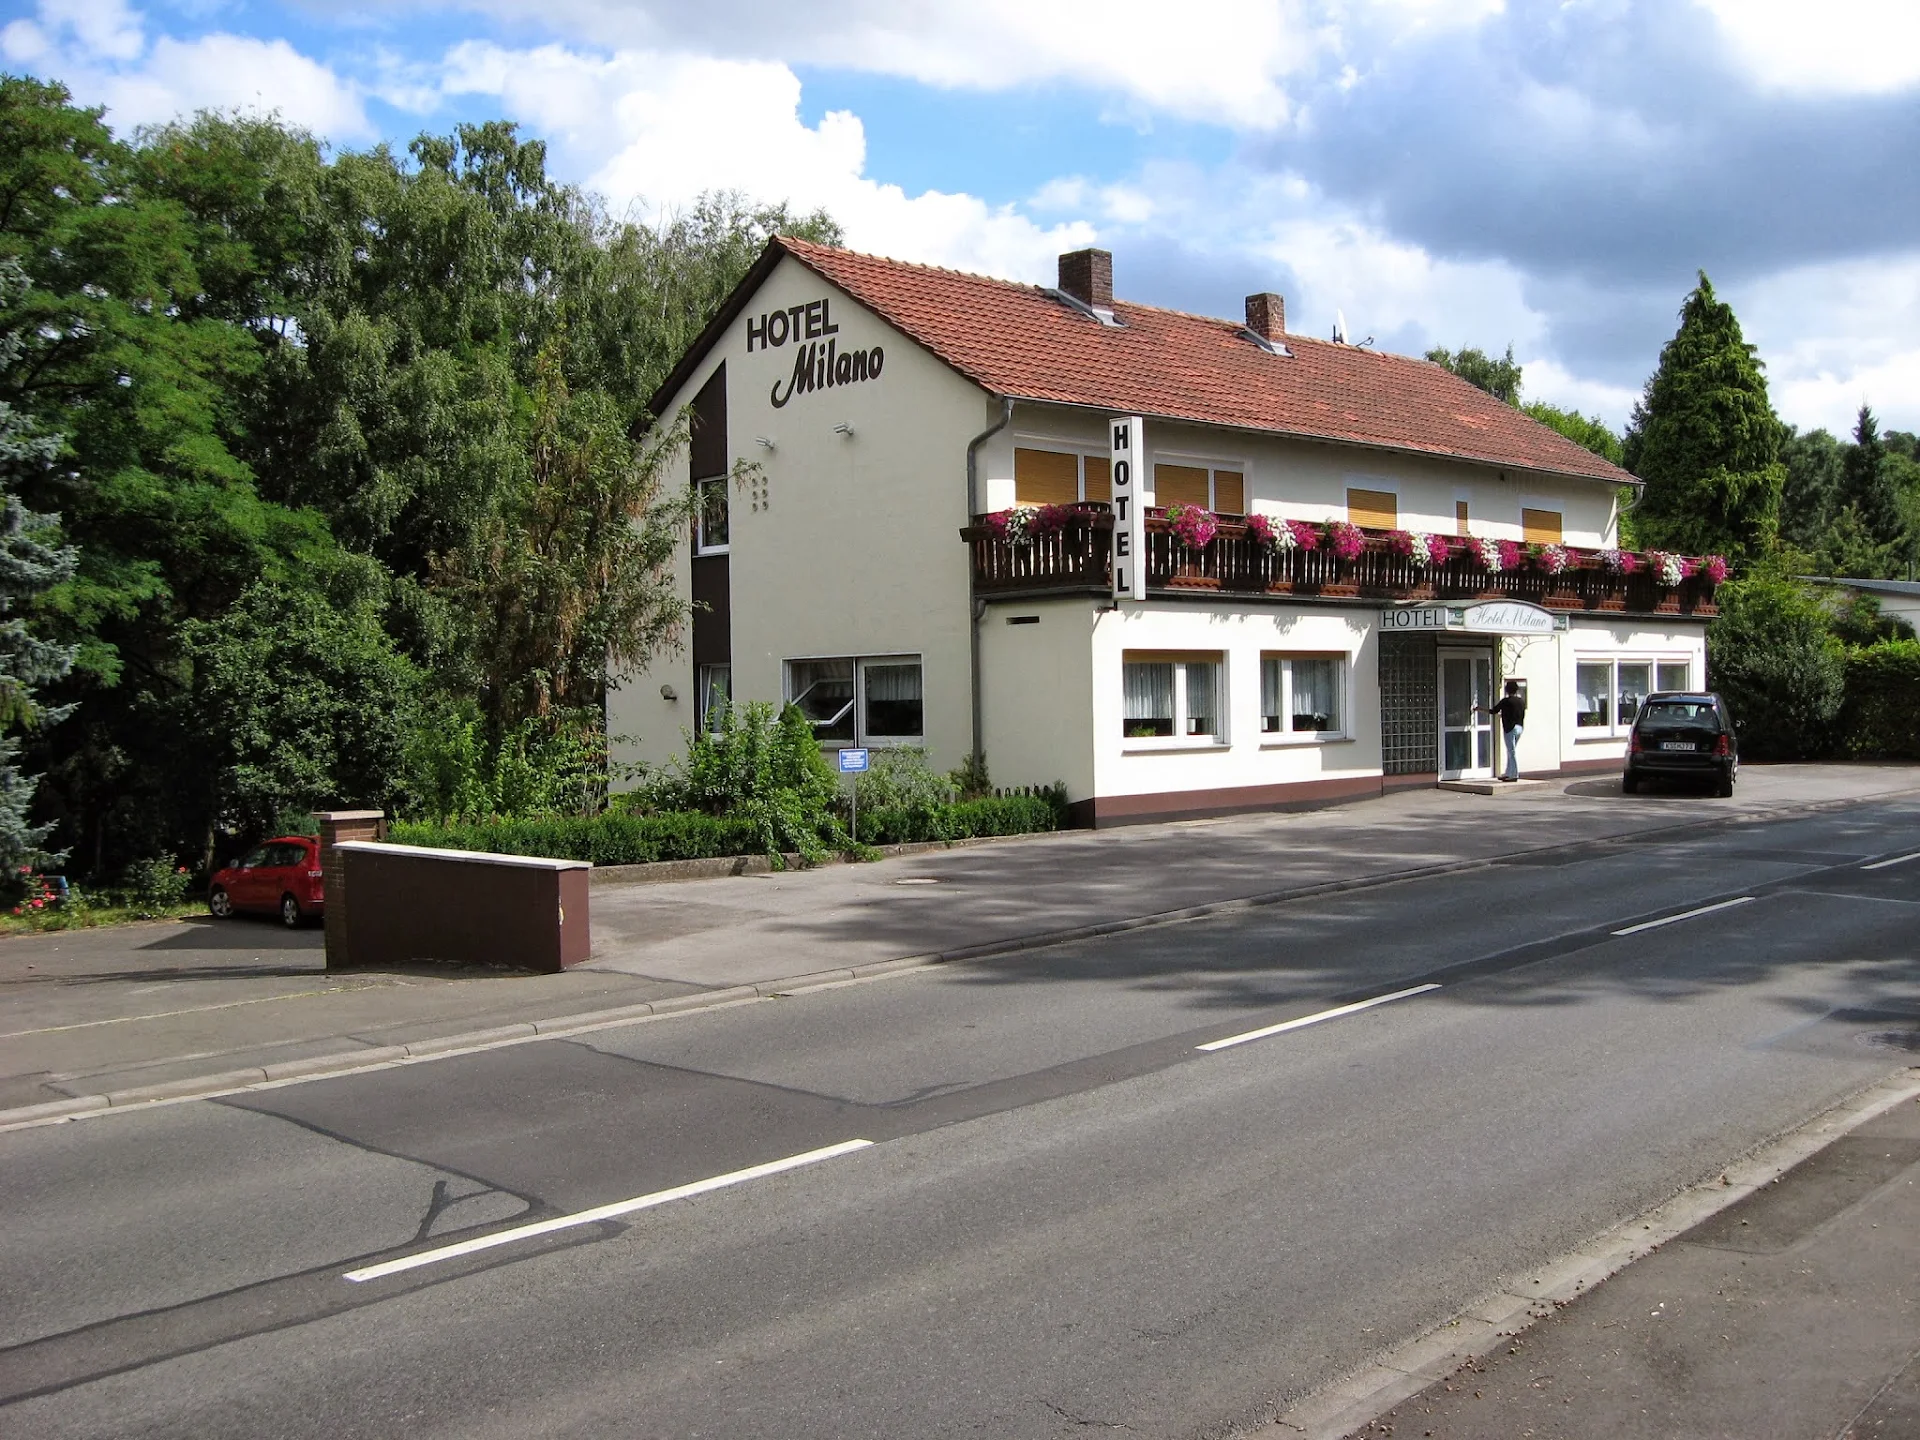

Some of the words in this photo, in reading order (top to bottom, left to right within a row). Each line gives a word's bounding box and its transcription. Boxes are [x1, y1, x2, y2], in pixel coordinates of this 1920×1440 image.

[747, 298, 839, 353] HOTEL
[770, 338, 885, 409] Milano
[1114, 425, 1130, 592] HOTEL
[1383, 609, 1443, 628] HOTEL
[1472, 605, 1504, 625] Hotel
[1506, 608, 1547, 627] Milano
